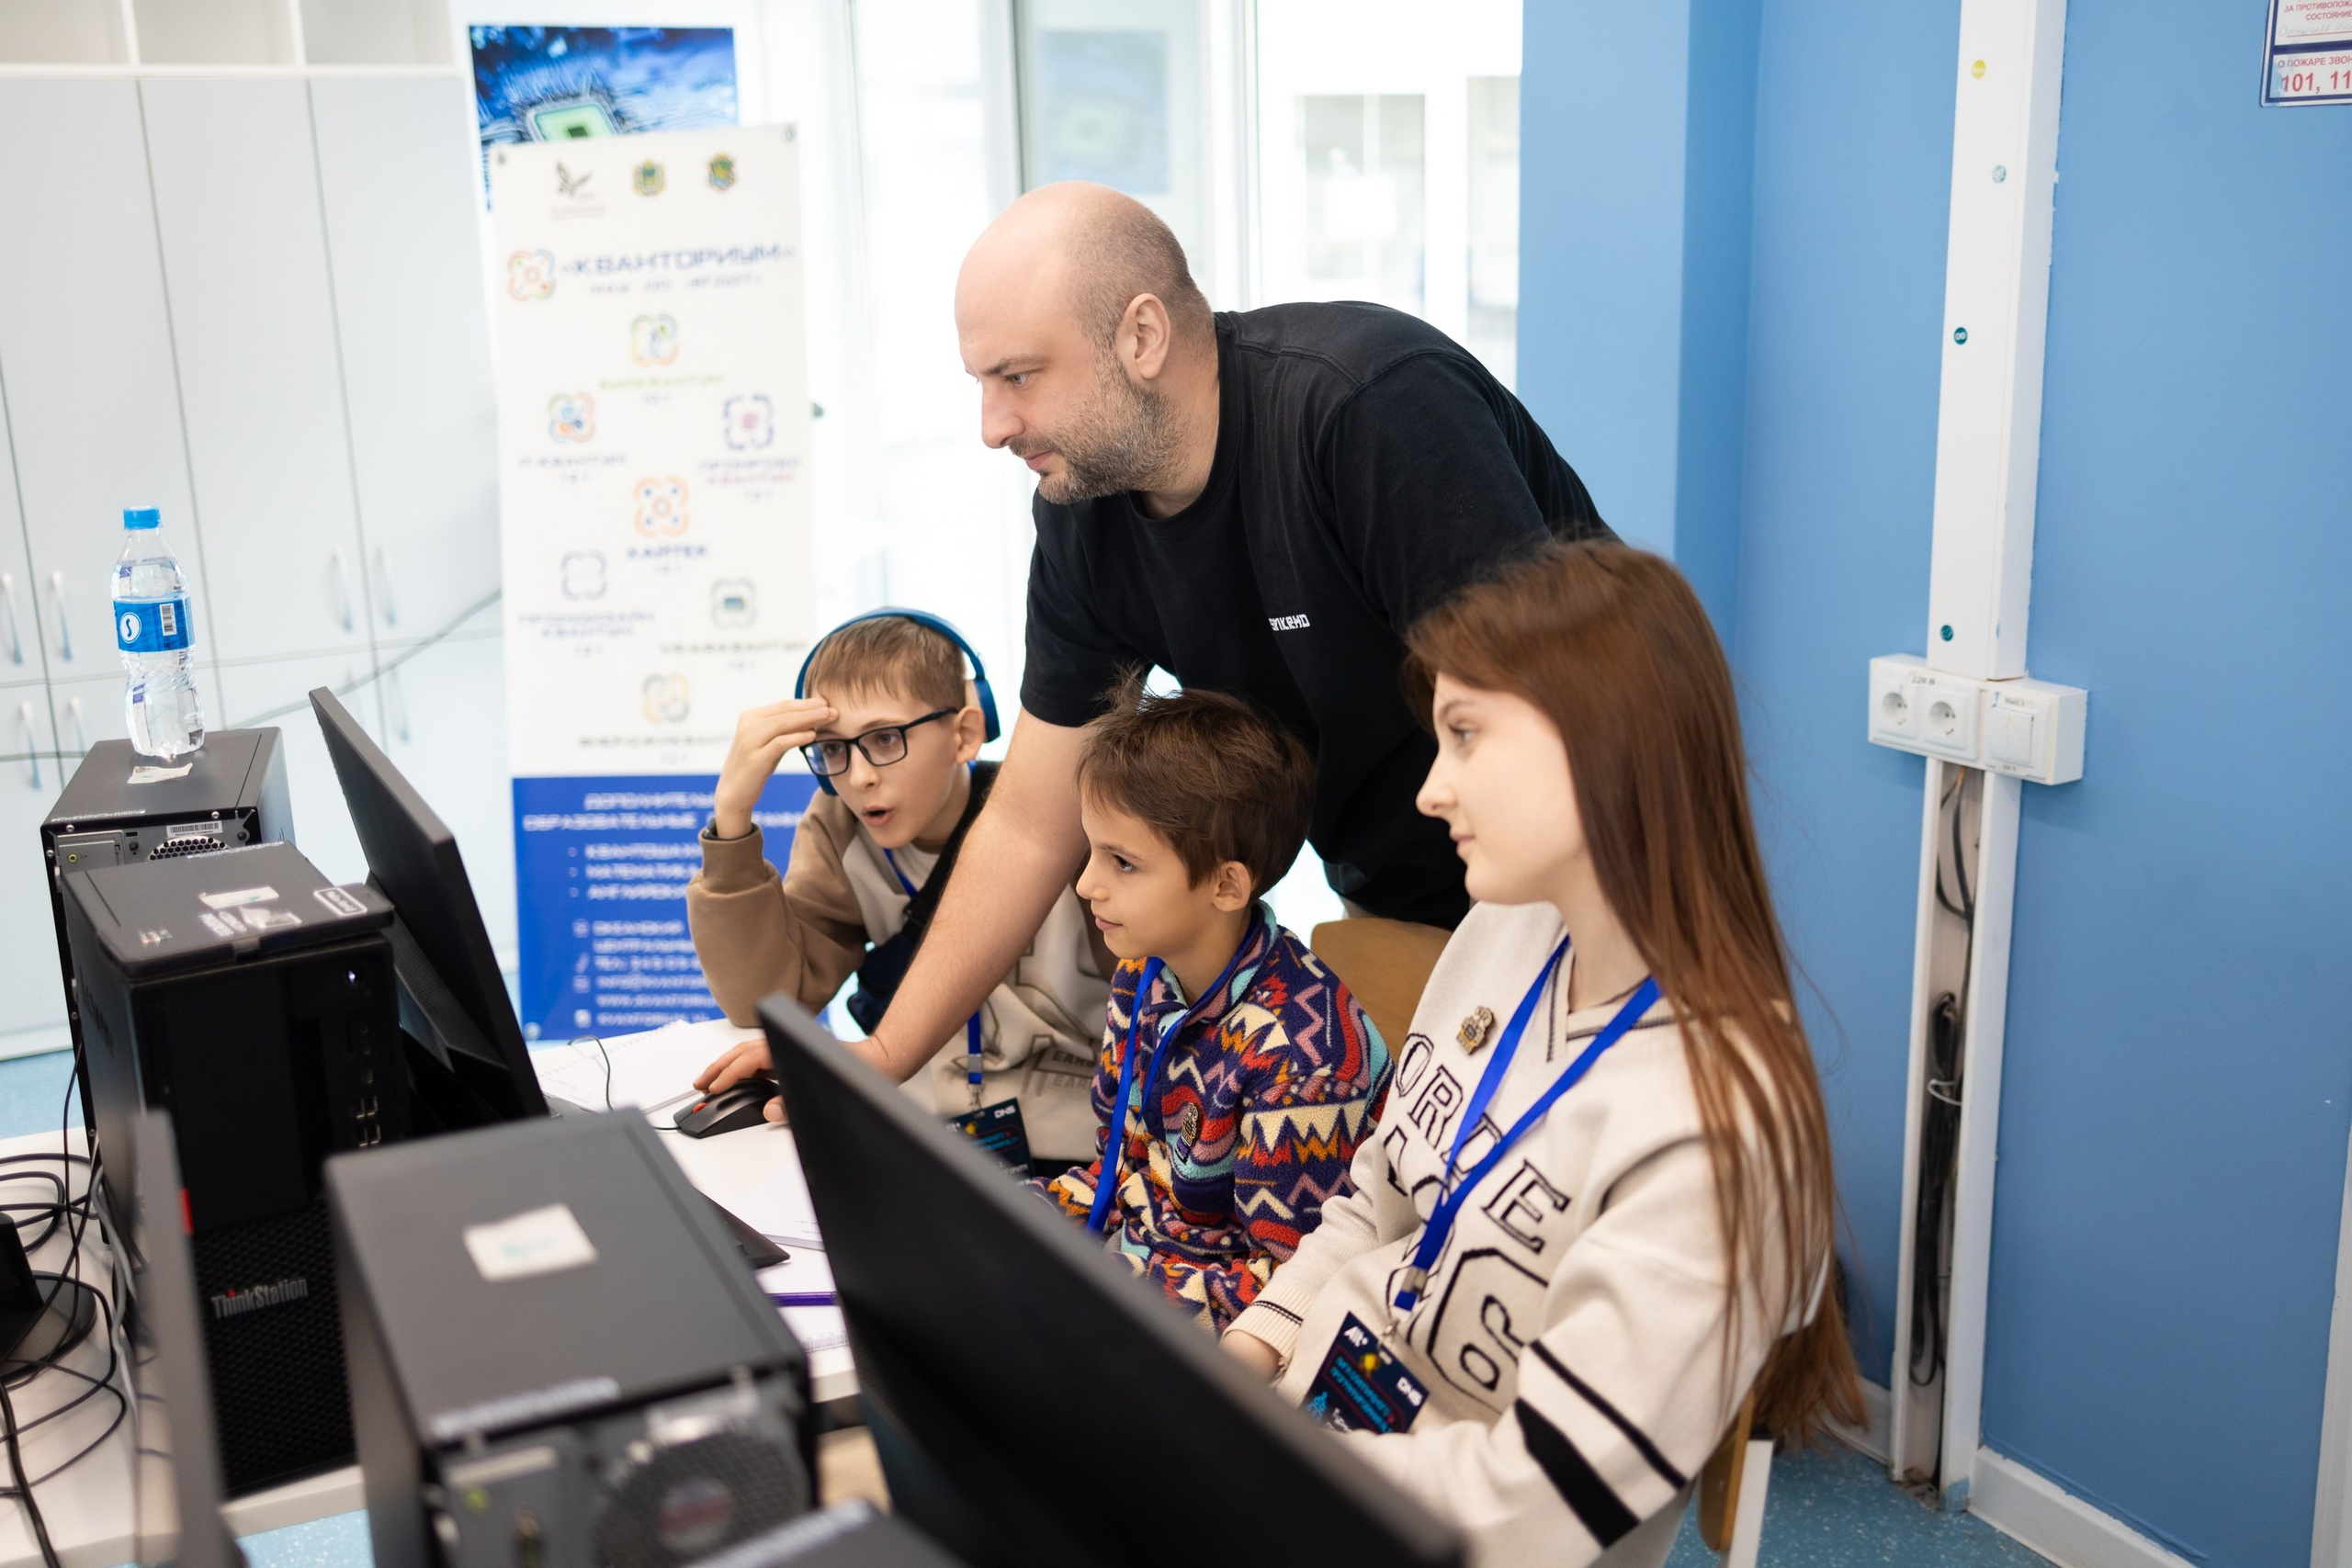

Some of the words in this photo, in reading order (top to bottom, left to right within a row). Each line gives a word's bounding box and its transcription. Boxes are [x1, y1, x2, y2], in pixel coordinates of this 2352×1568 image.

[2287, 57, 2325, 67] ПОЖАРЕ
[2281, 73, 2321, 94] 101,
[211, 1279, 309, 1319] ThinkStation
